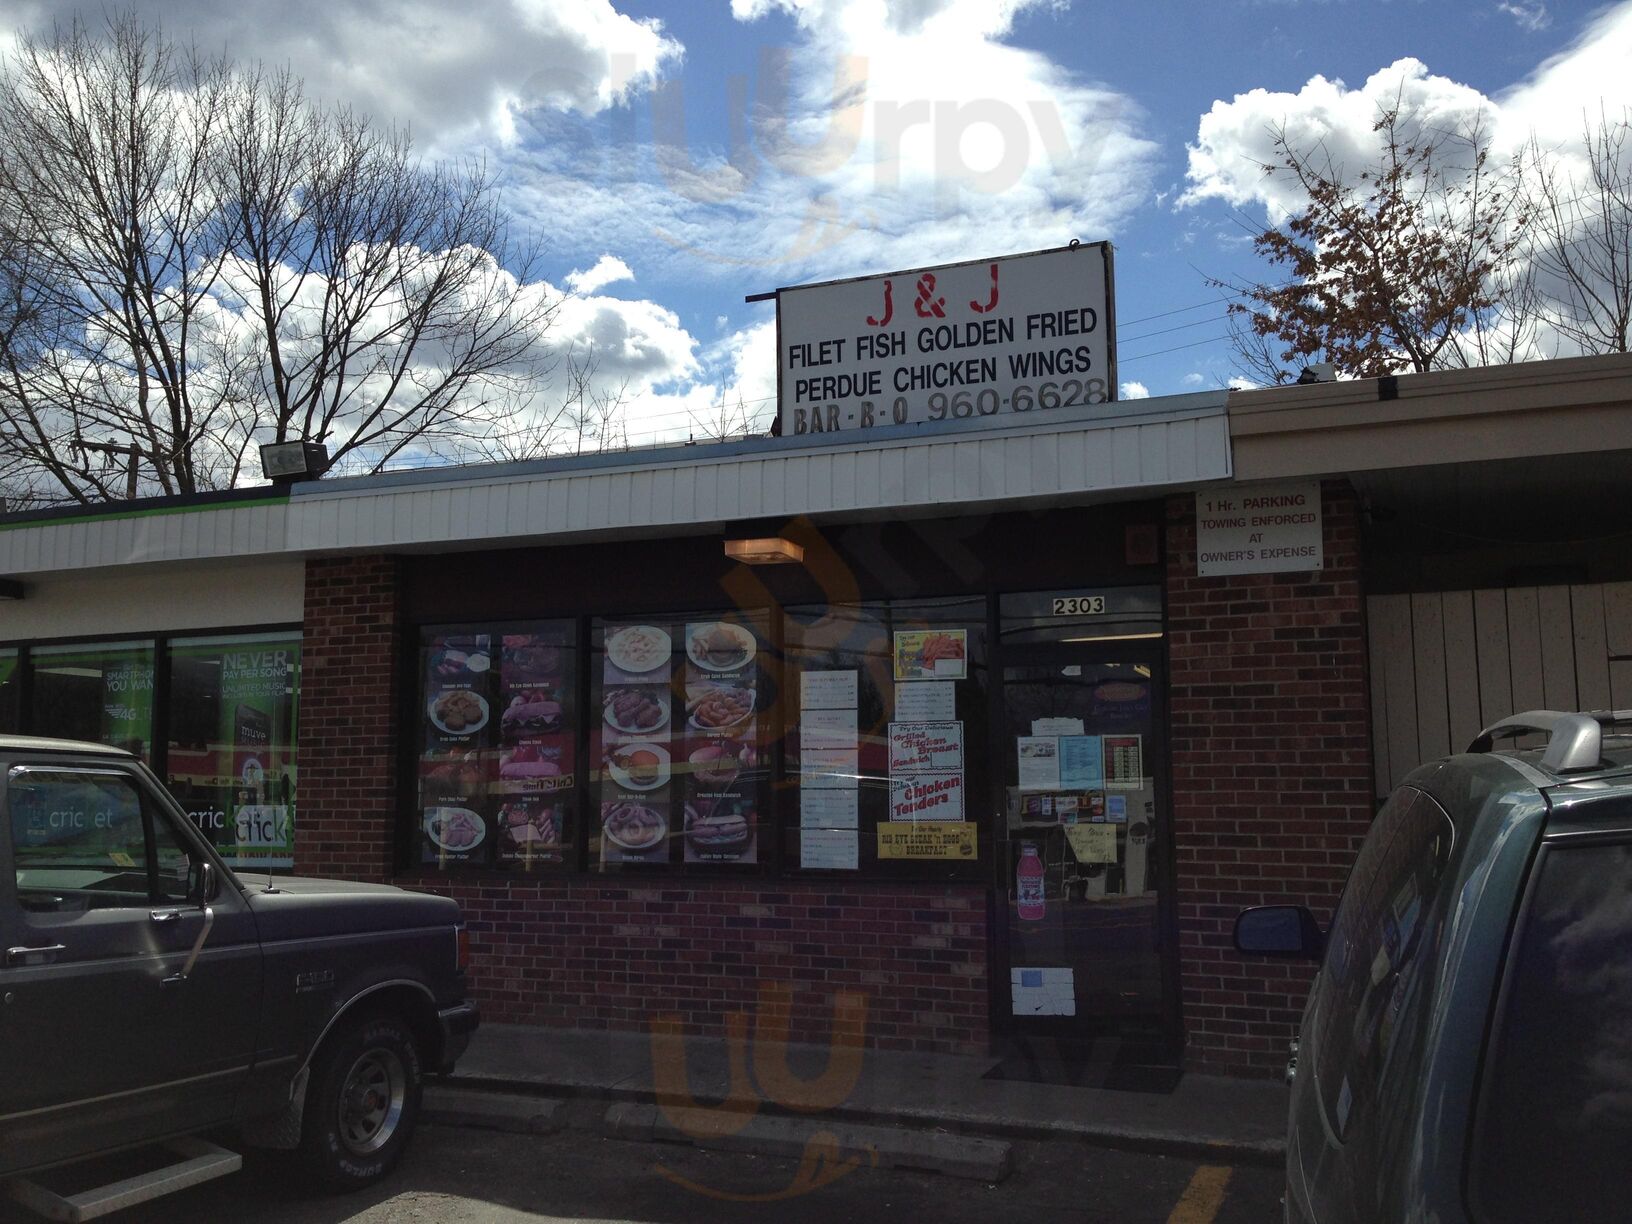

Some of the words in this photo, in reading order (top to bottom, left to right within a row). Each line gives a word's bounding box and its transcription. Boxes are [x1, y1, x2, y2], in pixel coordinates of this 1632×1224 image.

[866, 280, 893, 327] J
[914, 273, 946, 319] &
[969, 264, 999, 314] J
[789, 338, 846, 369] FILET
[856, 331, 906, 361] FISH
[917, 317, 1014, 353] GOLDEN
[1026, 307, 1097, 340] FRIED
[795, 370, 882, 403] PERDUE
[893, 357, 997, 392] CHICKEN
[1008, 346, 1091, 379] WINGS
[927, 378, 1108, 421] 960-6628
[1205, 502, 1212, 512] 1
[1217, 500, 1236, 512] Hr.
[1243, 494, 1306, 510] PARKING
[1201, 518, 1246, 530] TOWING
[1252, 513, 1316, 527] ENFORCED
[1249, 533, 1263, 543] AT
[1200, 550, 1255, 563] OWNER'S
[1260, 546, 1316, 559] EXPENSE
[1055, 597, 1103, 615] 2303
[223, 650, 287, 670] NEVER
[223, 670, 239, 680] PAY
[240, 669, 257, 679] PER
[259, 667, 287, 678] SONG
[107, 680, 127, 692] YOU
[262, 681, 286, 691] MUSIC
[120, 708, 137, 721] 4G
[241, 726, 266, 740] muve
[893, 731, 926, 742] Grilled
[901, 737, 947, 749] Chicken
[917, 743, 959, 755] Breast
[904, 776, 960, 800] Chicken
[895, 793, 949, 816] Tenders
[49, 806, 113, 829] cricet
